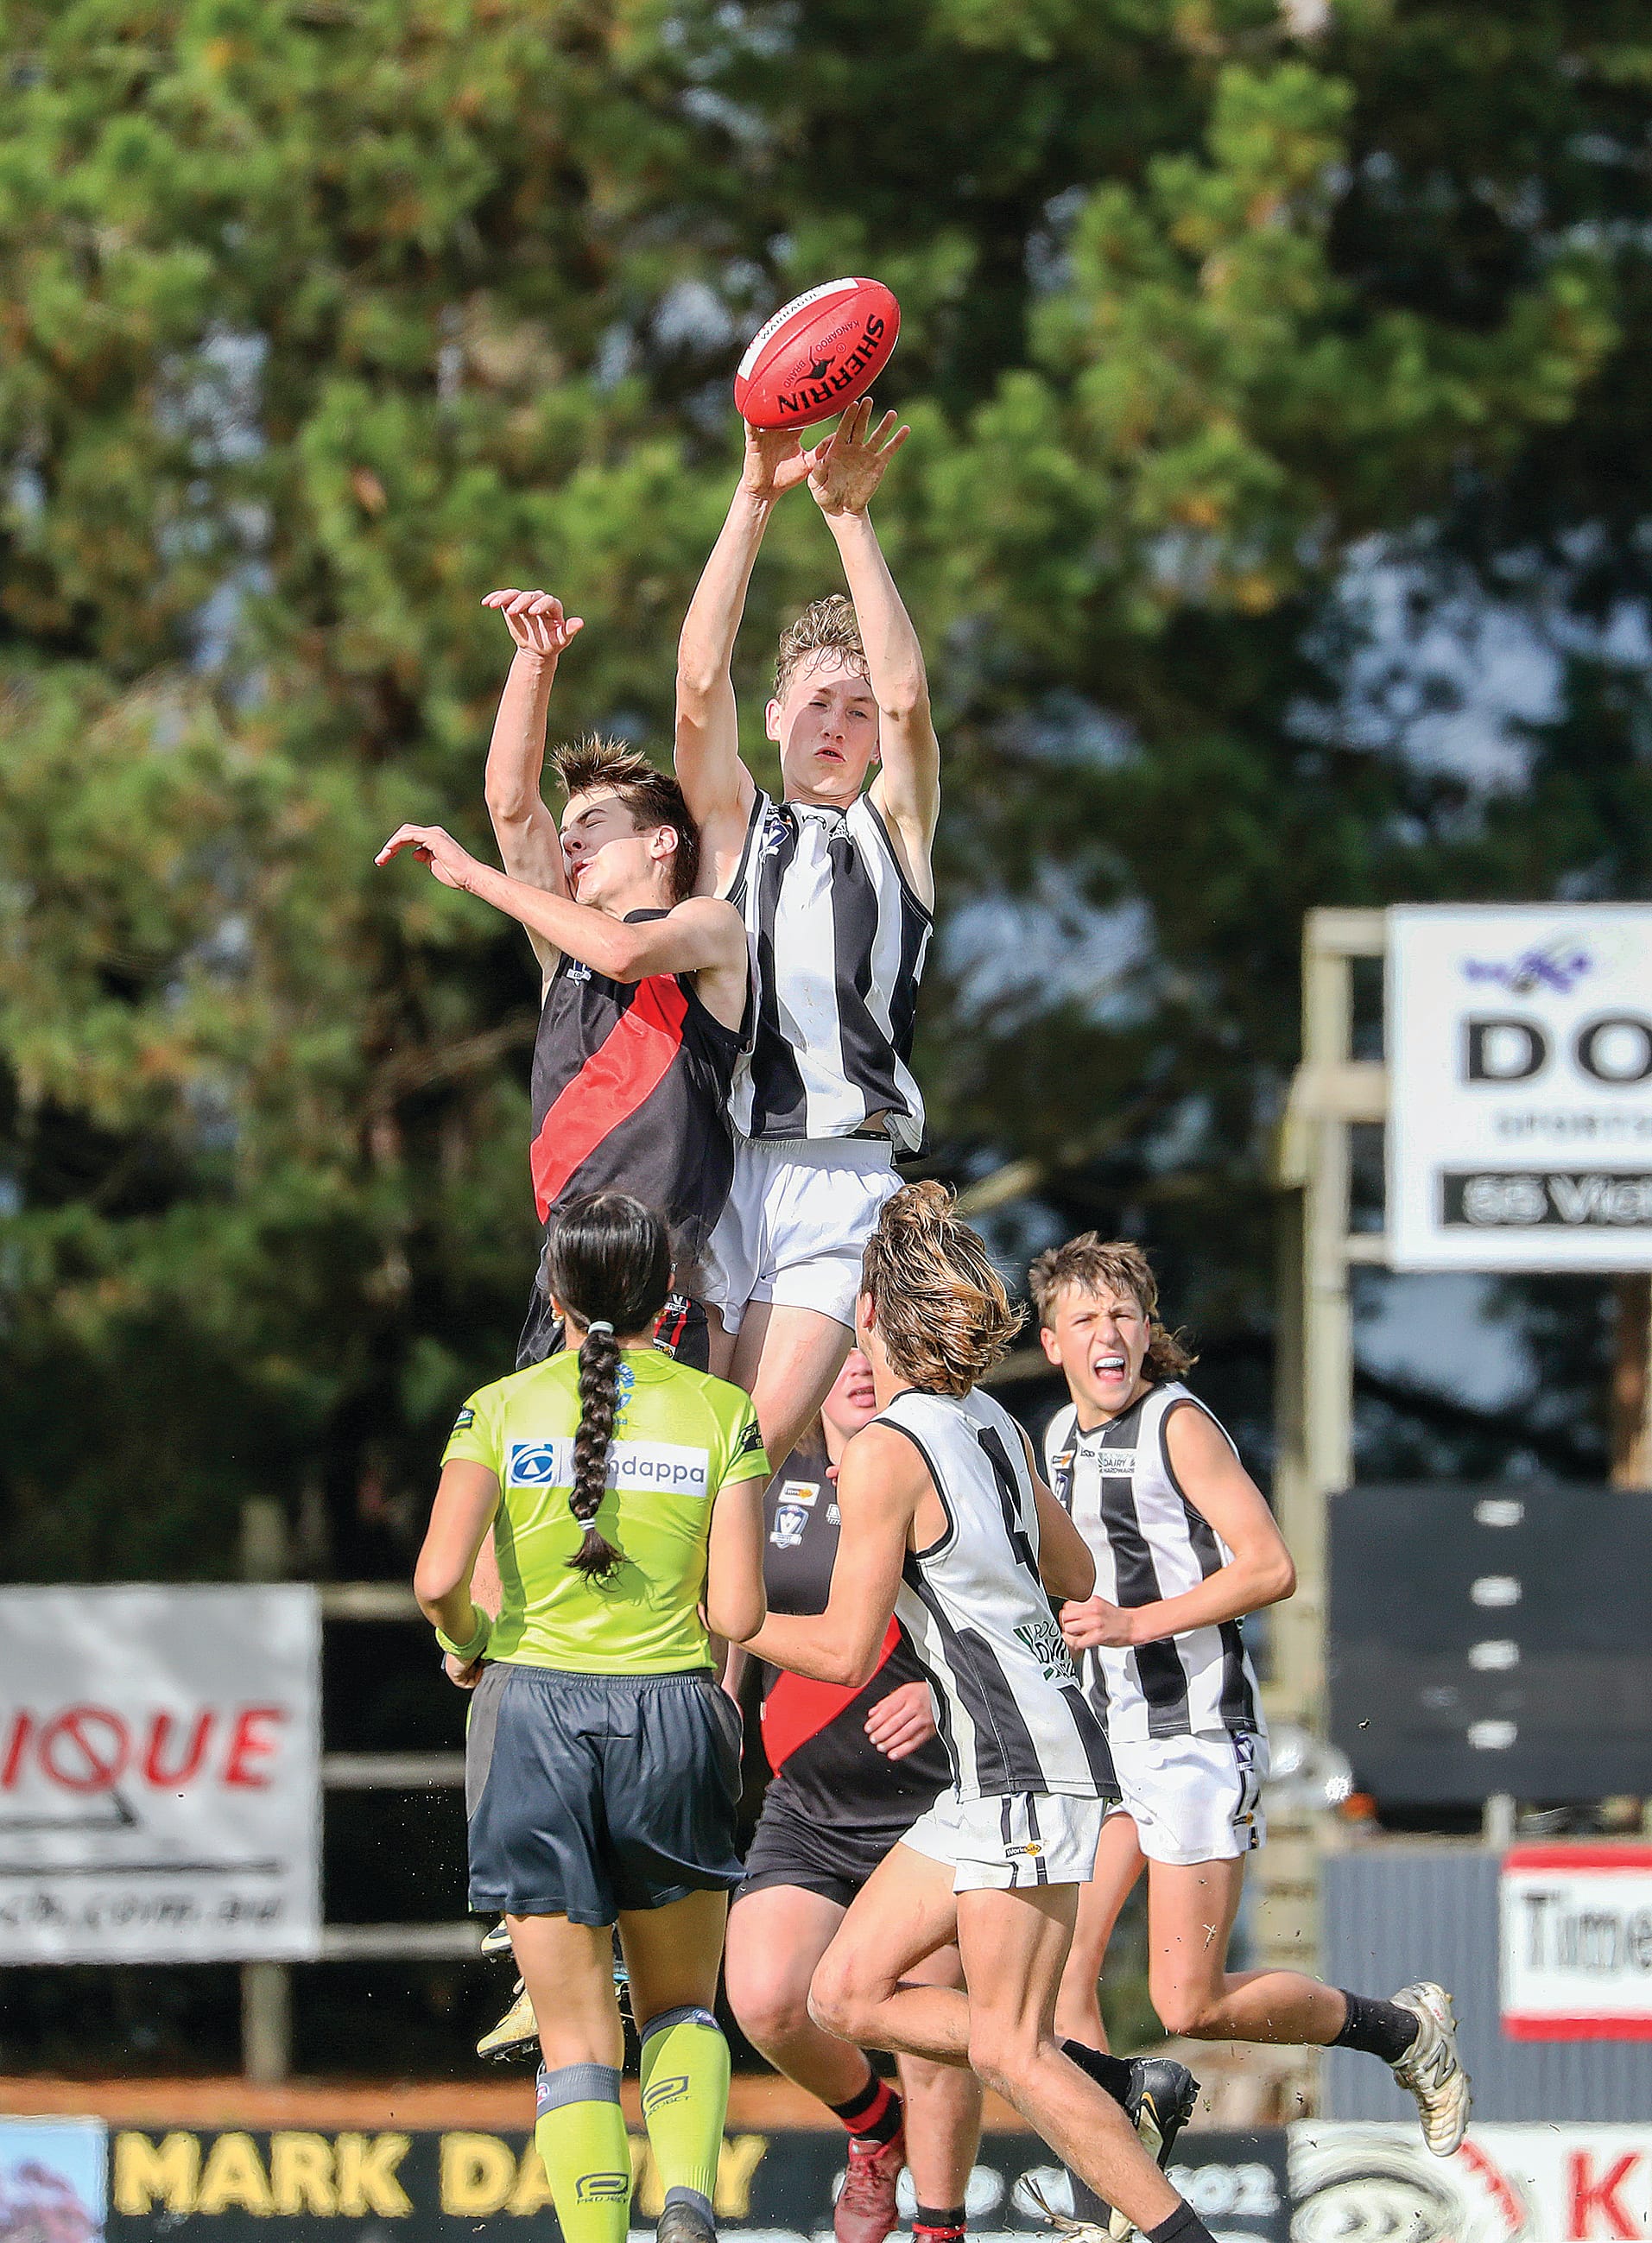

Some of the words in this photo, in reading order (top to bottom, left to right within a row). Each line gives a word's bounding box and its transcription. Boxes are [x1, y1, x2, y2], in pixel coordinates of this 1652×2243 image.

[777, 314, 885, 415] SHERRIN
[815, 320, 860, 353] KANGAROO
[783, 358, 807, 389] BRAND
[1468, 1017, 1652, 1082] DO
[608, 1456, 705, 1484] ndappa
[2, 1702, 287, 1796] IQUE
[113, 2131, 415, 2218] MARK
[439, 2131, 769, 2219] DAY
